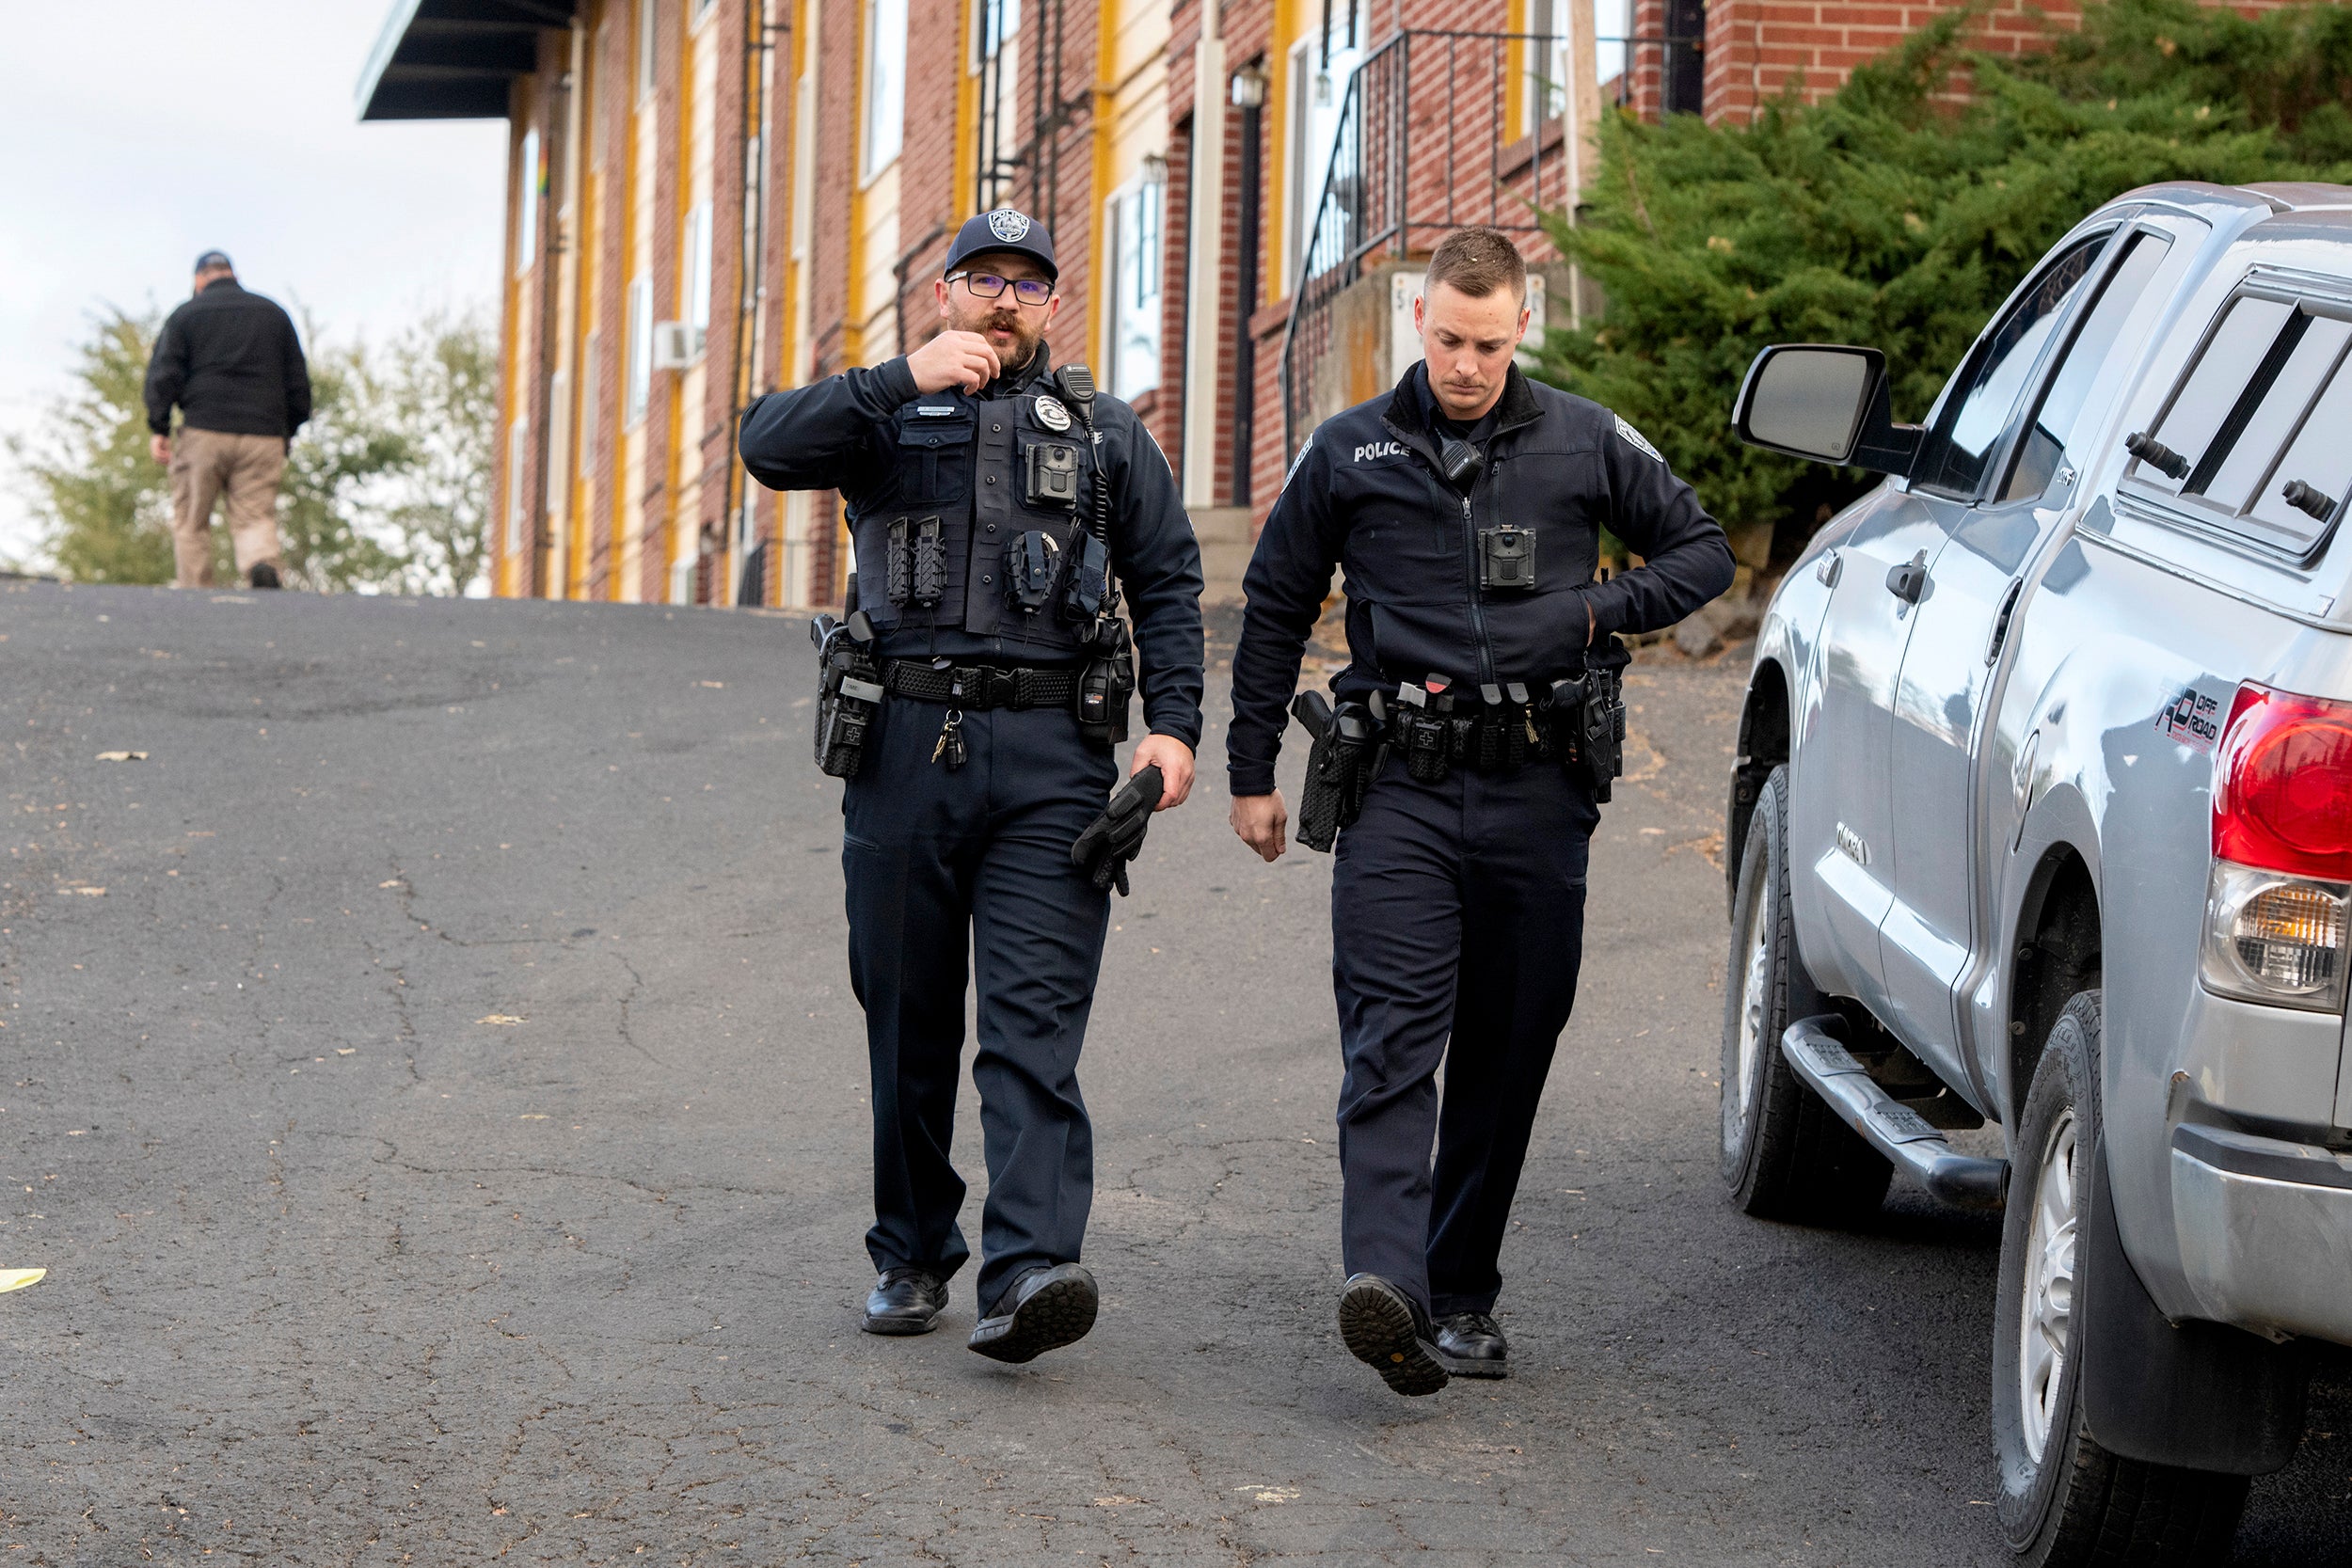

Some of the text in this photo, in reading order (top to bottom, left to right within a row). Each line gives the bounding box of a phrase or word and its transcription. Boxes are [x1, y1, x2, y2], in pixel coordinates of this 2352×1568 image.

[993, 211, 1026, 227] POLICE
[1354, 441, 1411, 462] POLICE
[2196, 694, 2218, 715] OFF
[2187, 715, 2217, 741] ROAD
